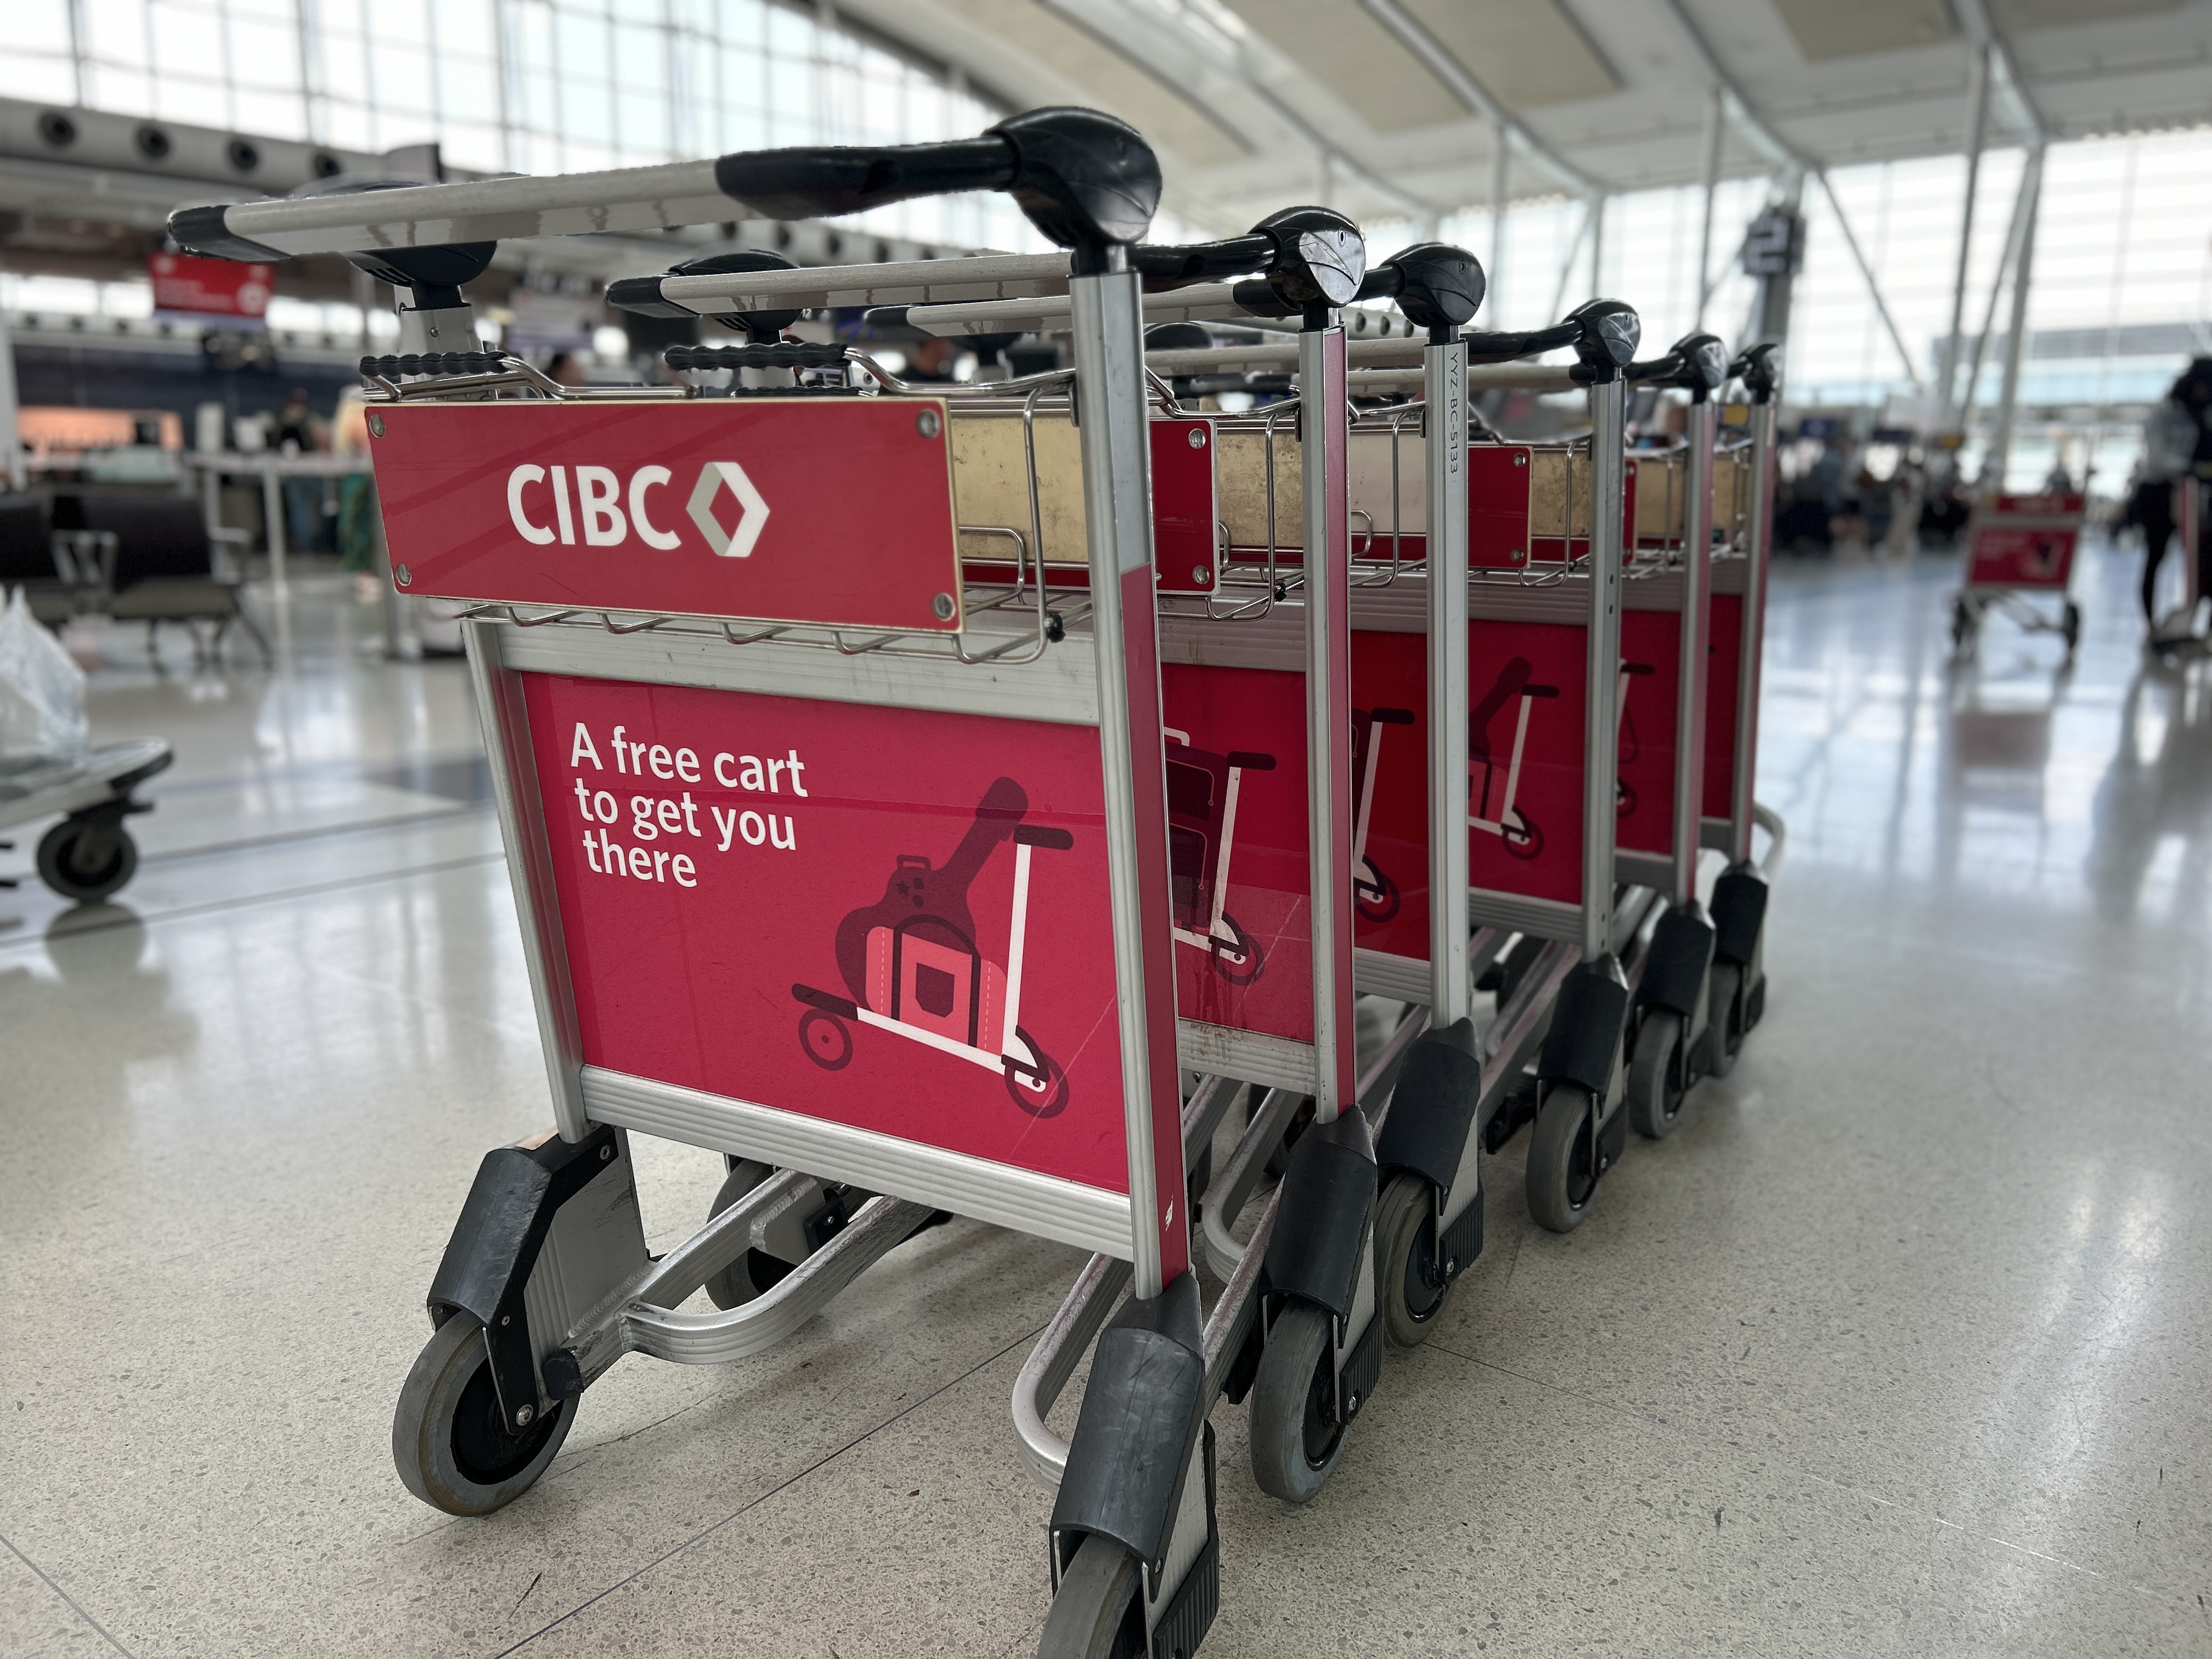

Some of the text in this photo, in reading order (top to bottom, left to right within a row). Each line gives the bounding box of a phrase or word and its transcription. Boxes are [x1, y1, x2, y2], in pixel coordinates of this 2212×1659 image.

[1450, 352, 1458, 474] YYZ-BC-5133
[507, 464, 682, 550] CIBC
[571, 722, 809, 797] A free cart
[574, 777, 797, 852] to get you
[582, 828, 697, 888] there
